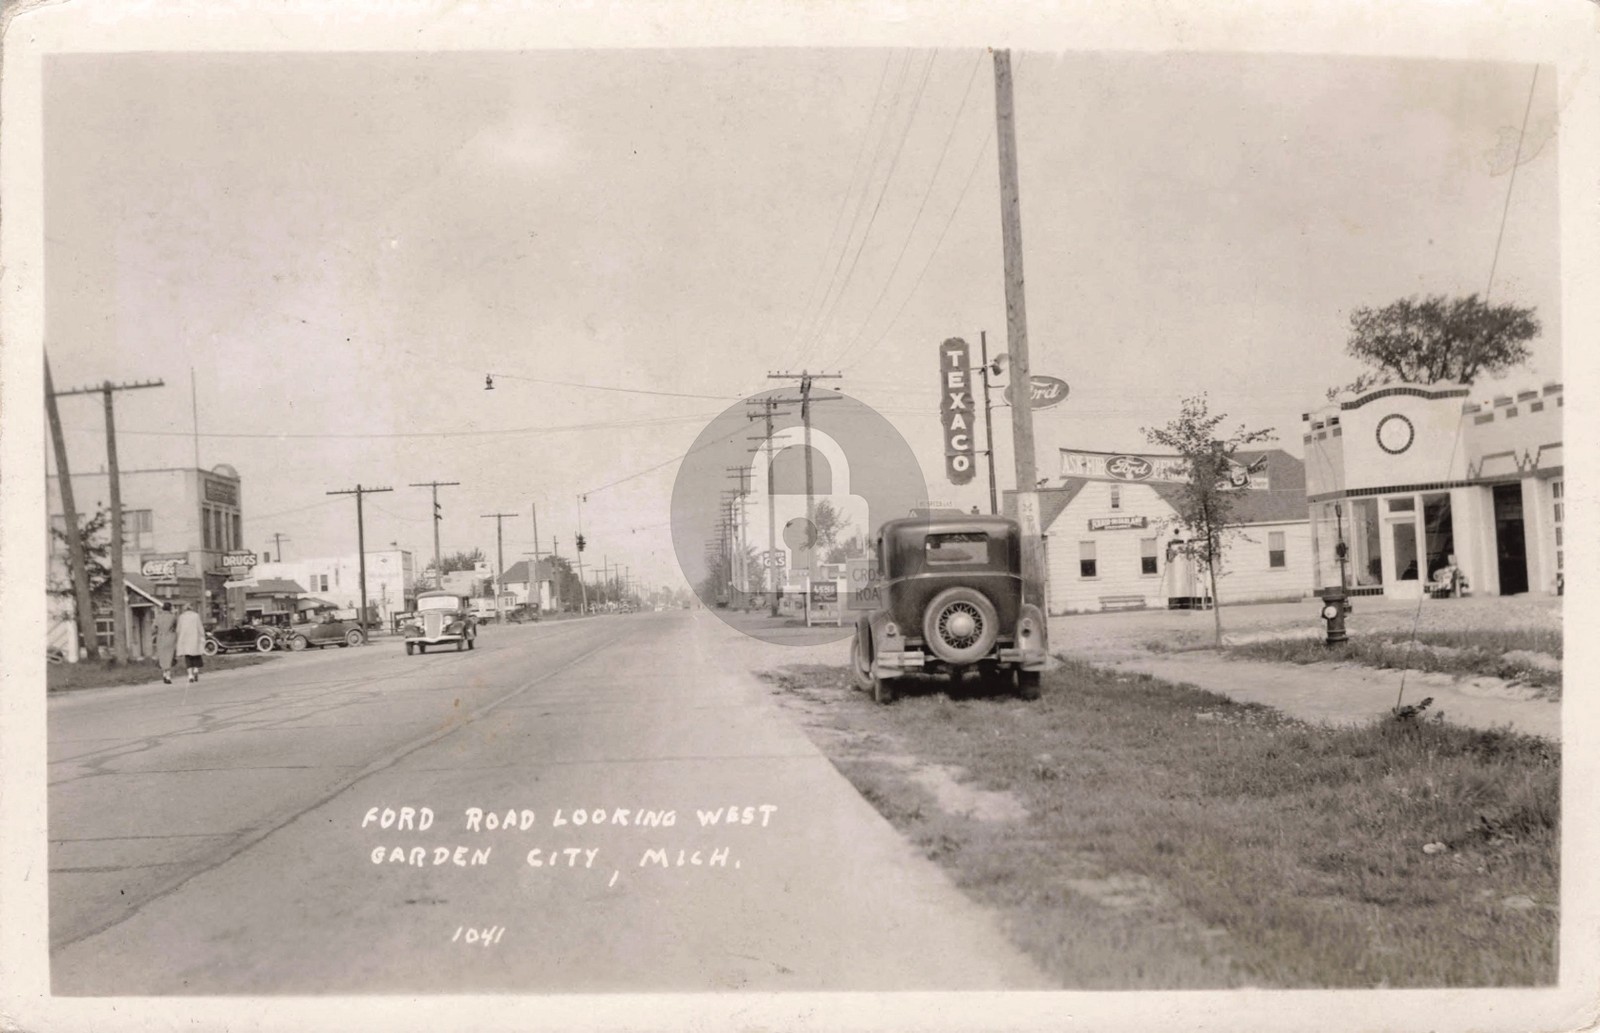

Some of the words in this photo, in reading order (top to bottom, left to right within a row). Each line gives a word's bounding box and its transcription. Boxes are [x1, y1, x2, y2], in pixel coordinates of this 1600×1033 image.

[947, 350, 970, 471] TEXACO
[1110, 459, 1148, 475] Ford
[222, 555, 256, 567] DRUGS
[852, 568, 880, 582] CRO
[855, 587, 880, 601] ROA
